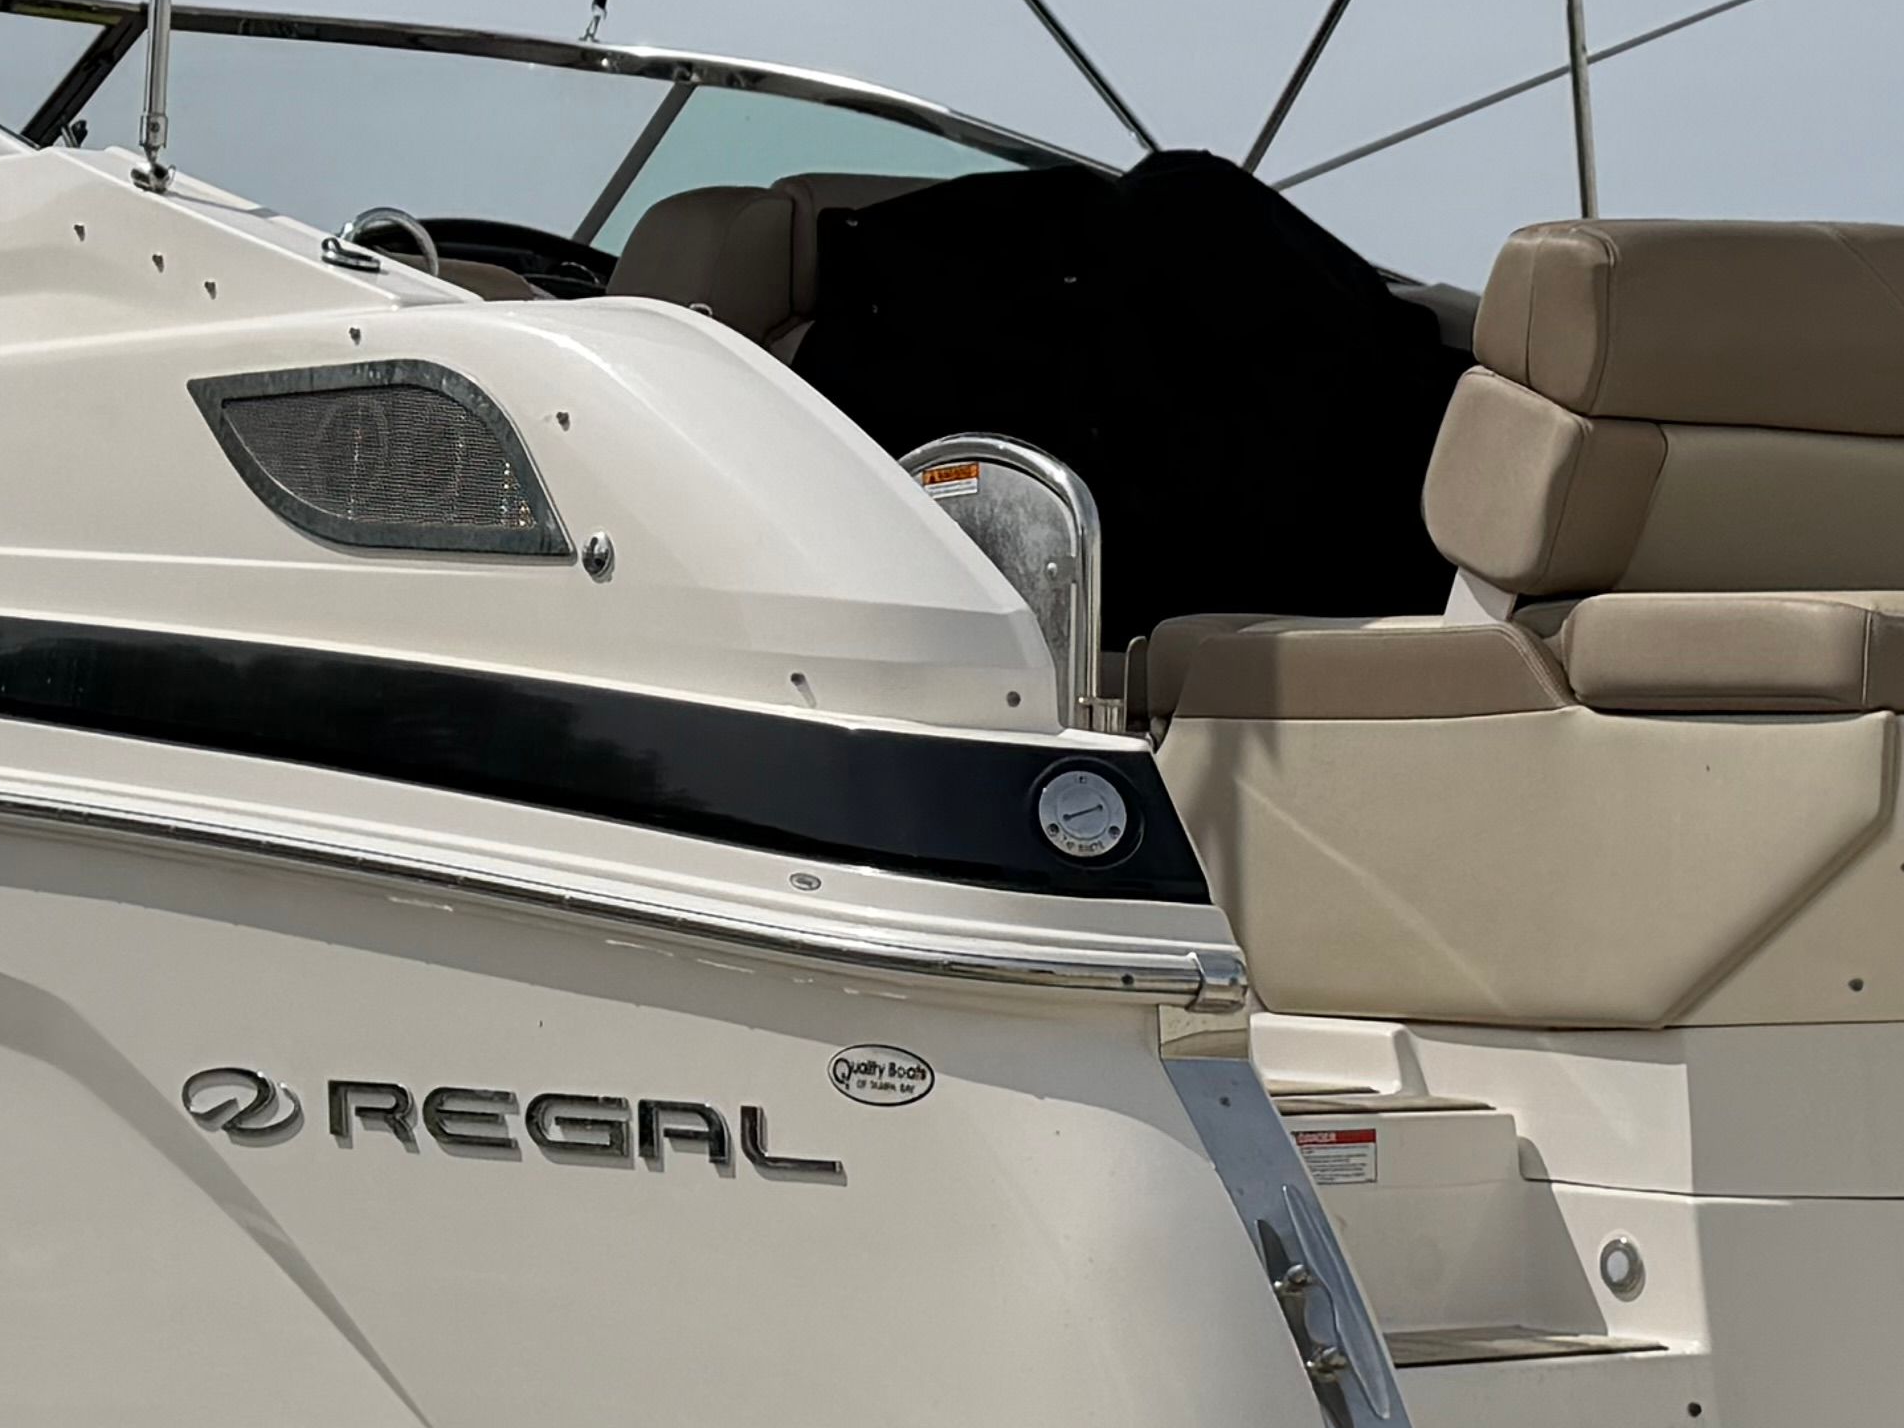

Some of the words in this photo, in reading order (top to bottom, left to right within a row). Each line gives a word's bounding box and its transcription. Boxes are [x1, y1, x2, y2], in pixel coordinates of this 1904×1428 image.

[833, 1058, 885, 1090] Quality
[888, 1062, 926, 1080] Boats
[328, 1078, 844, 1174] REGAL
